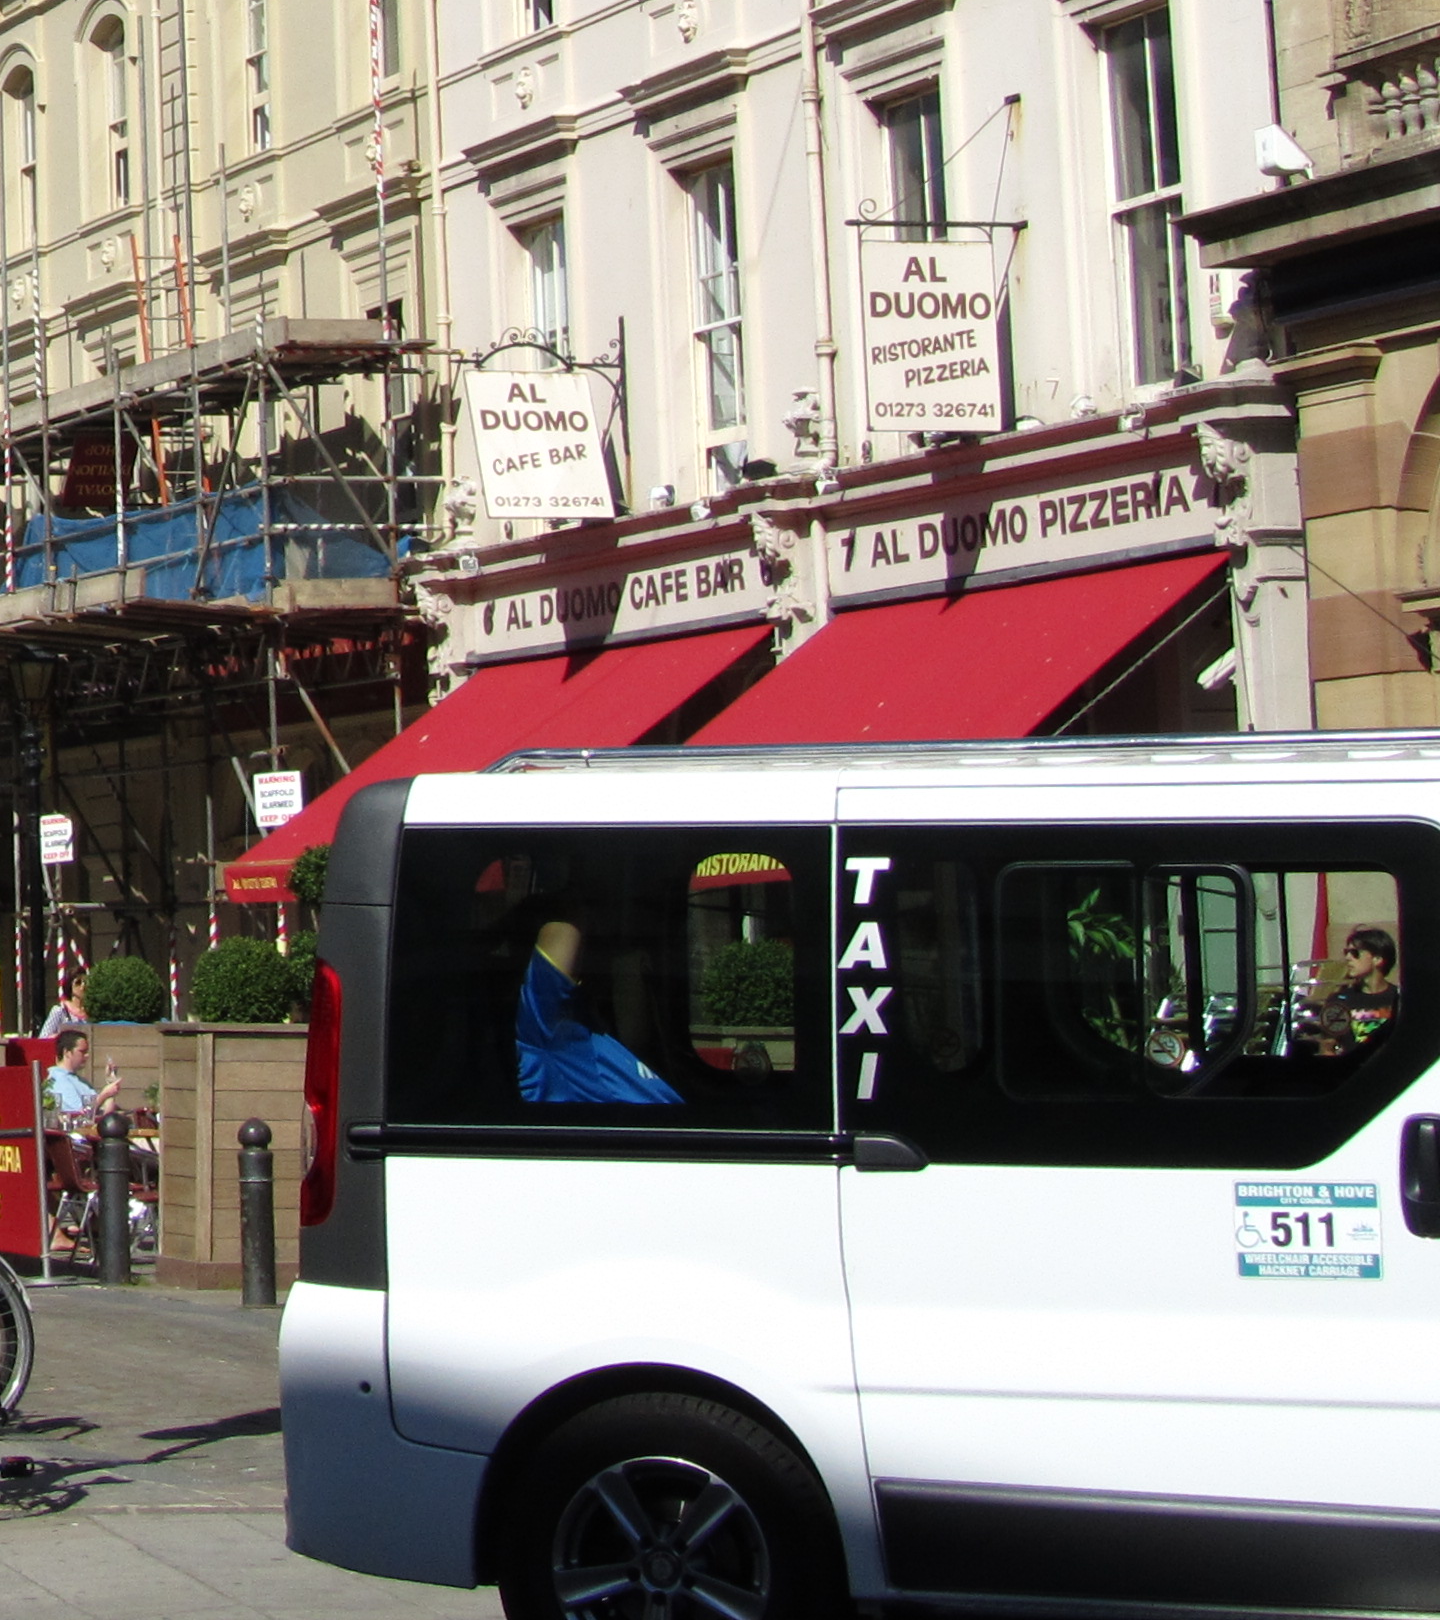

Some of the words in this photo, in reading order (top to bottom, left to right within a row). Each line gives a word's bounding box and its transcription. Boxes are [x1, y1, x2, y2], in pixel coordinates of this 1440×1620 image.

[902, 256, 947, 282] AL
[870, 292, 991, 320] DUOMO
[872, 329, 977, 365] RISTORANTE
[904, 357, 990, 388] PIZZERIA
[508, 382, 547, 403] AL
[480, 410, 588, 432] DUOMO
[875, 402, 926, 417] 01273
[932, 402, 995, 418] 326741
[492, 452, 542, 476] CAFE
[548, 444, 587, 465] BAR
[495, 496, 542, 507] 01273
[549, 496, 605, 507] 326741
[871, 529, 910, 568] AL
[918, 505, 1028, 560] DUOMO
[1039, 474, 1191, 538] PIZZERIA
[507, 598, 532, 631] AL
[540, 582, 620, 626] DUOMO
[629, 569, 689, 610] CAFE
[696, 558, 746, 598] BAR
[258, 776, 295, 784] WARNING
[696, 853, 785, 877] RISTORANT
[837, 857, 893, 1100] TAXI
[1238, 1185, 1314, 1198] BRIGHTON
[1318, 1186, 1330, 1198] &
[1334, 1186, 1374, 1198] HOVE
[1270, 1212, 1334, 1248] 511
[1244, 1254, 1310, 1264] WHEELCHAIR
[1312, 1254, 1374, 1266] ACCESSIBLE
[1258, 1265, 1306, 1276] HACKNEY
[1308, 1266, 1360, 1276] CARRIAGE
